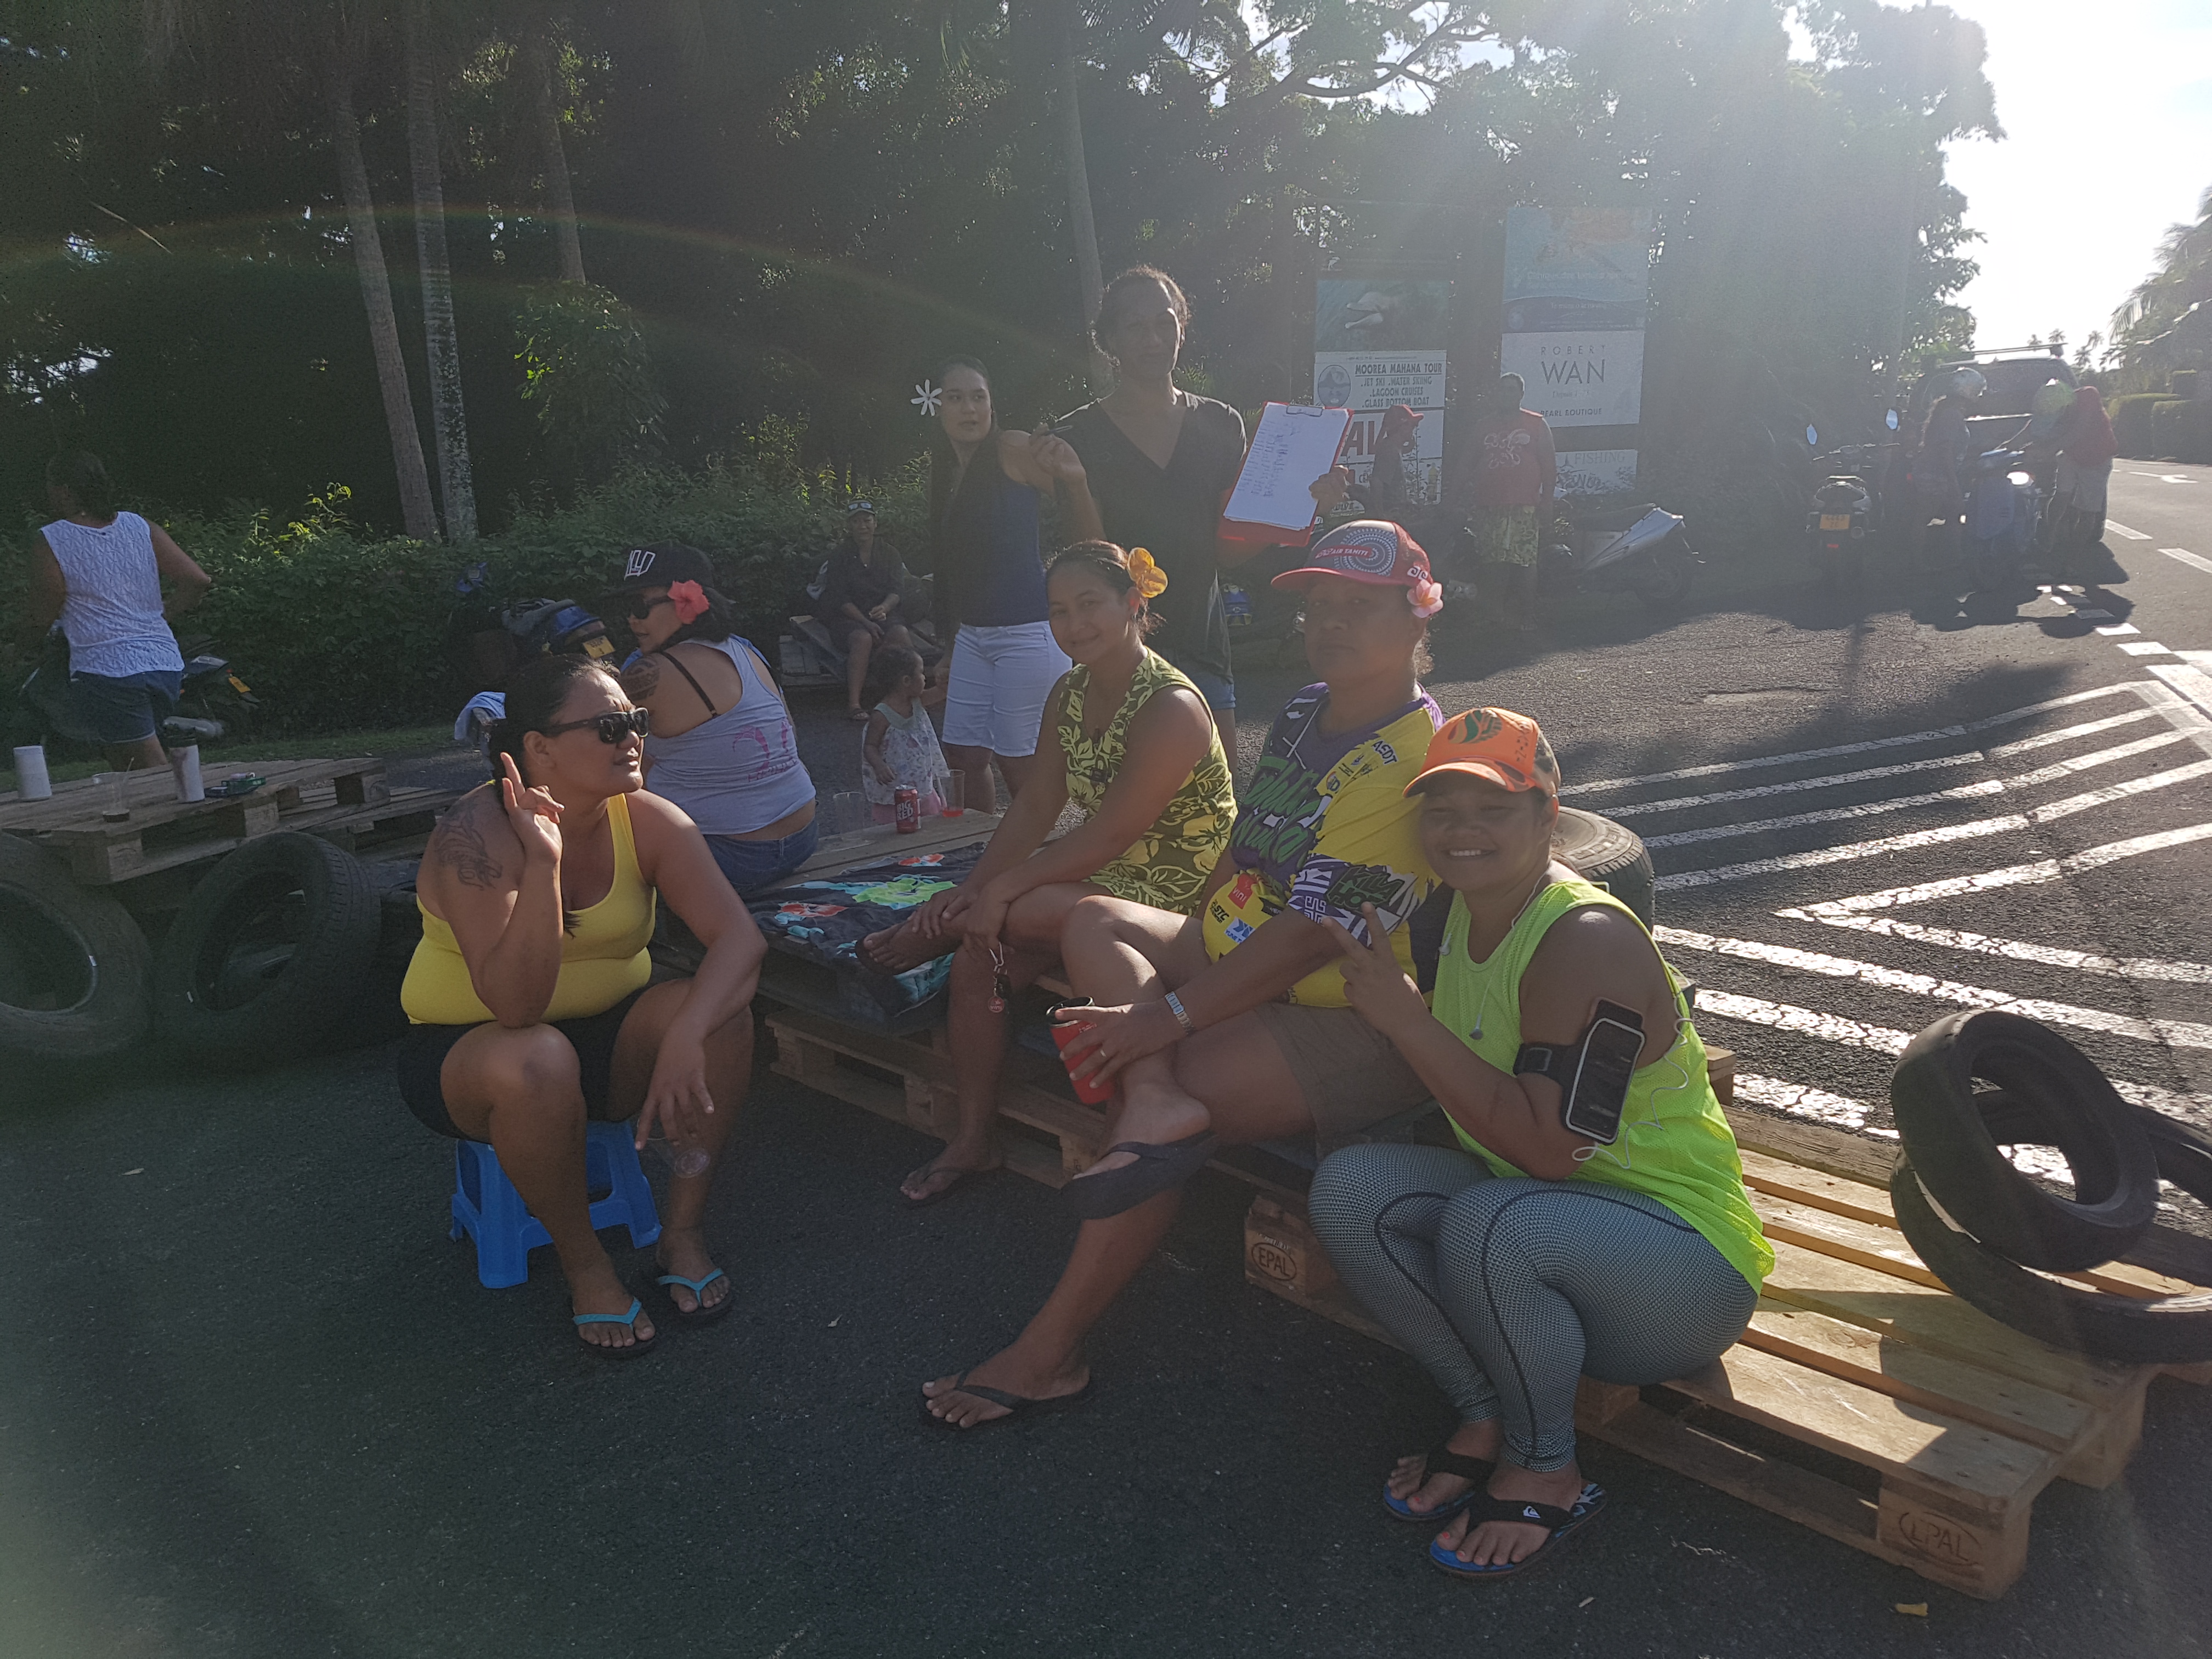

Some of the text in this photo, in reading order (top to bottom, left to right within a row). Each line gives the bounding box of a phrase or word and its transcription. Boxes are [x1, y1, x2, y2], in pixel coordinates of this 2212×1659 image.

[1541, 345, 1606, 356] ROBERT
[1355, 363, 1442, 374] MOOREA MAHANA TOUR
[1541, 359, 1606, 385] WAN
[1375, 377, 1385, 386] SKI
[1413, 376, 1432, 385] SKIING
[1401, 387, 1424, 396] CRUISES
[1413, 397, 1430, 405] BOAT
[1565, 408, 1602, 416] BOUTIQUE
[1575, 452, 1626, 465] FISHING
[897, 799, 911, 812] BIG
[897, 808, 913, 821] RED
[1213, 905, 1229, 922] STC
[1259, 1246, 1290, 1277] EPAL
